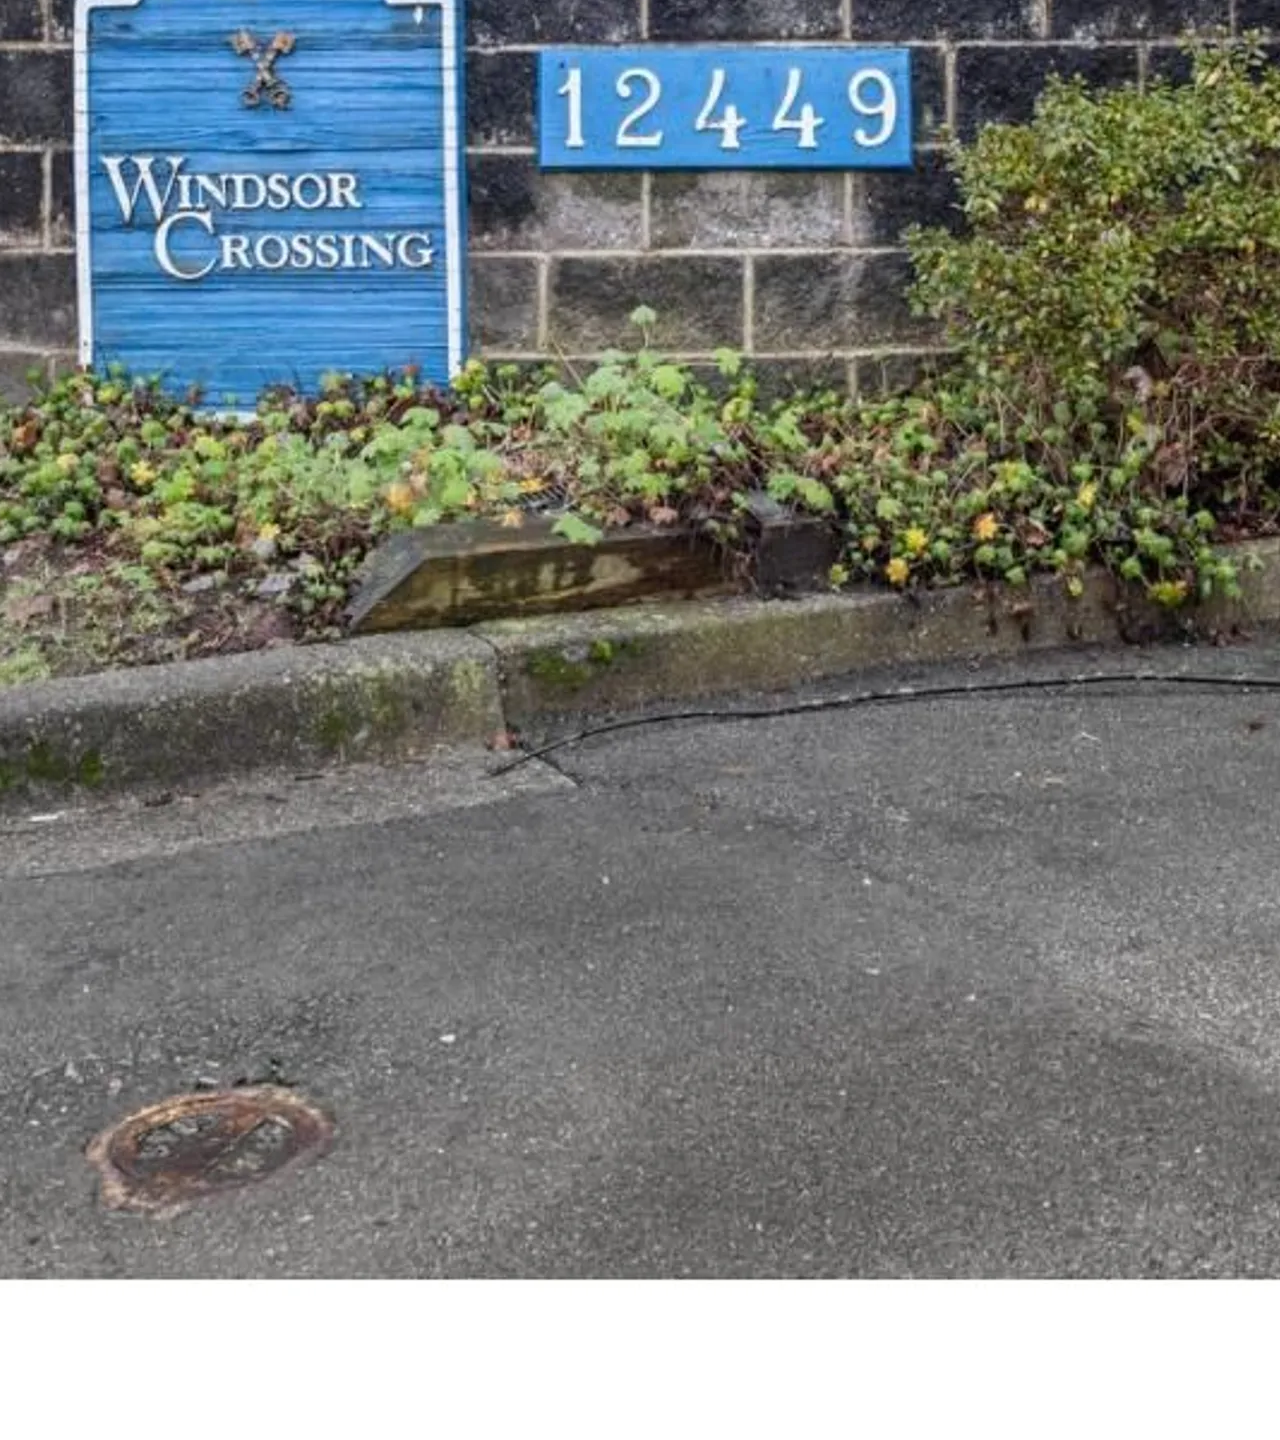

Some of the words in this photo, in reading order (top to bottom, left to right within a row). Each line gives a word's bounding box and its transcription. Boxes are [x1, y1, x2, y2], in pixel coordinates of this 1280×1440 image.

[557, 66, 898, 149] 12449
[101, 155, 362, 225] WINDSOR
[154, 211, 436, 281] CROSSING
